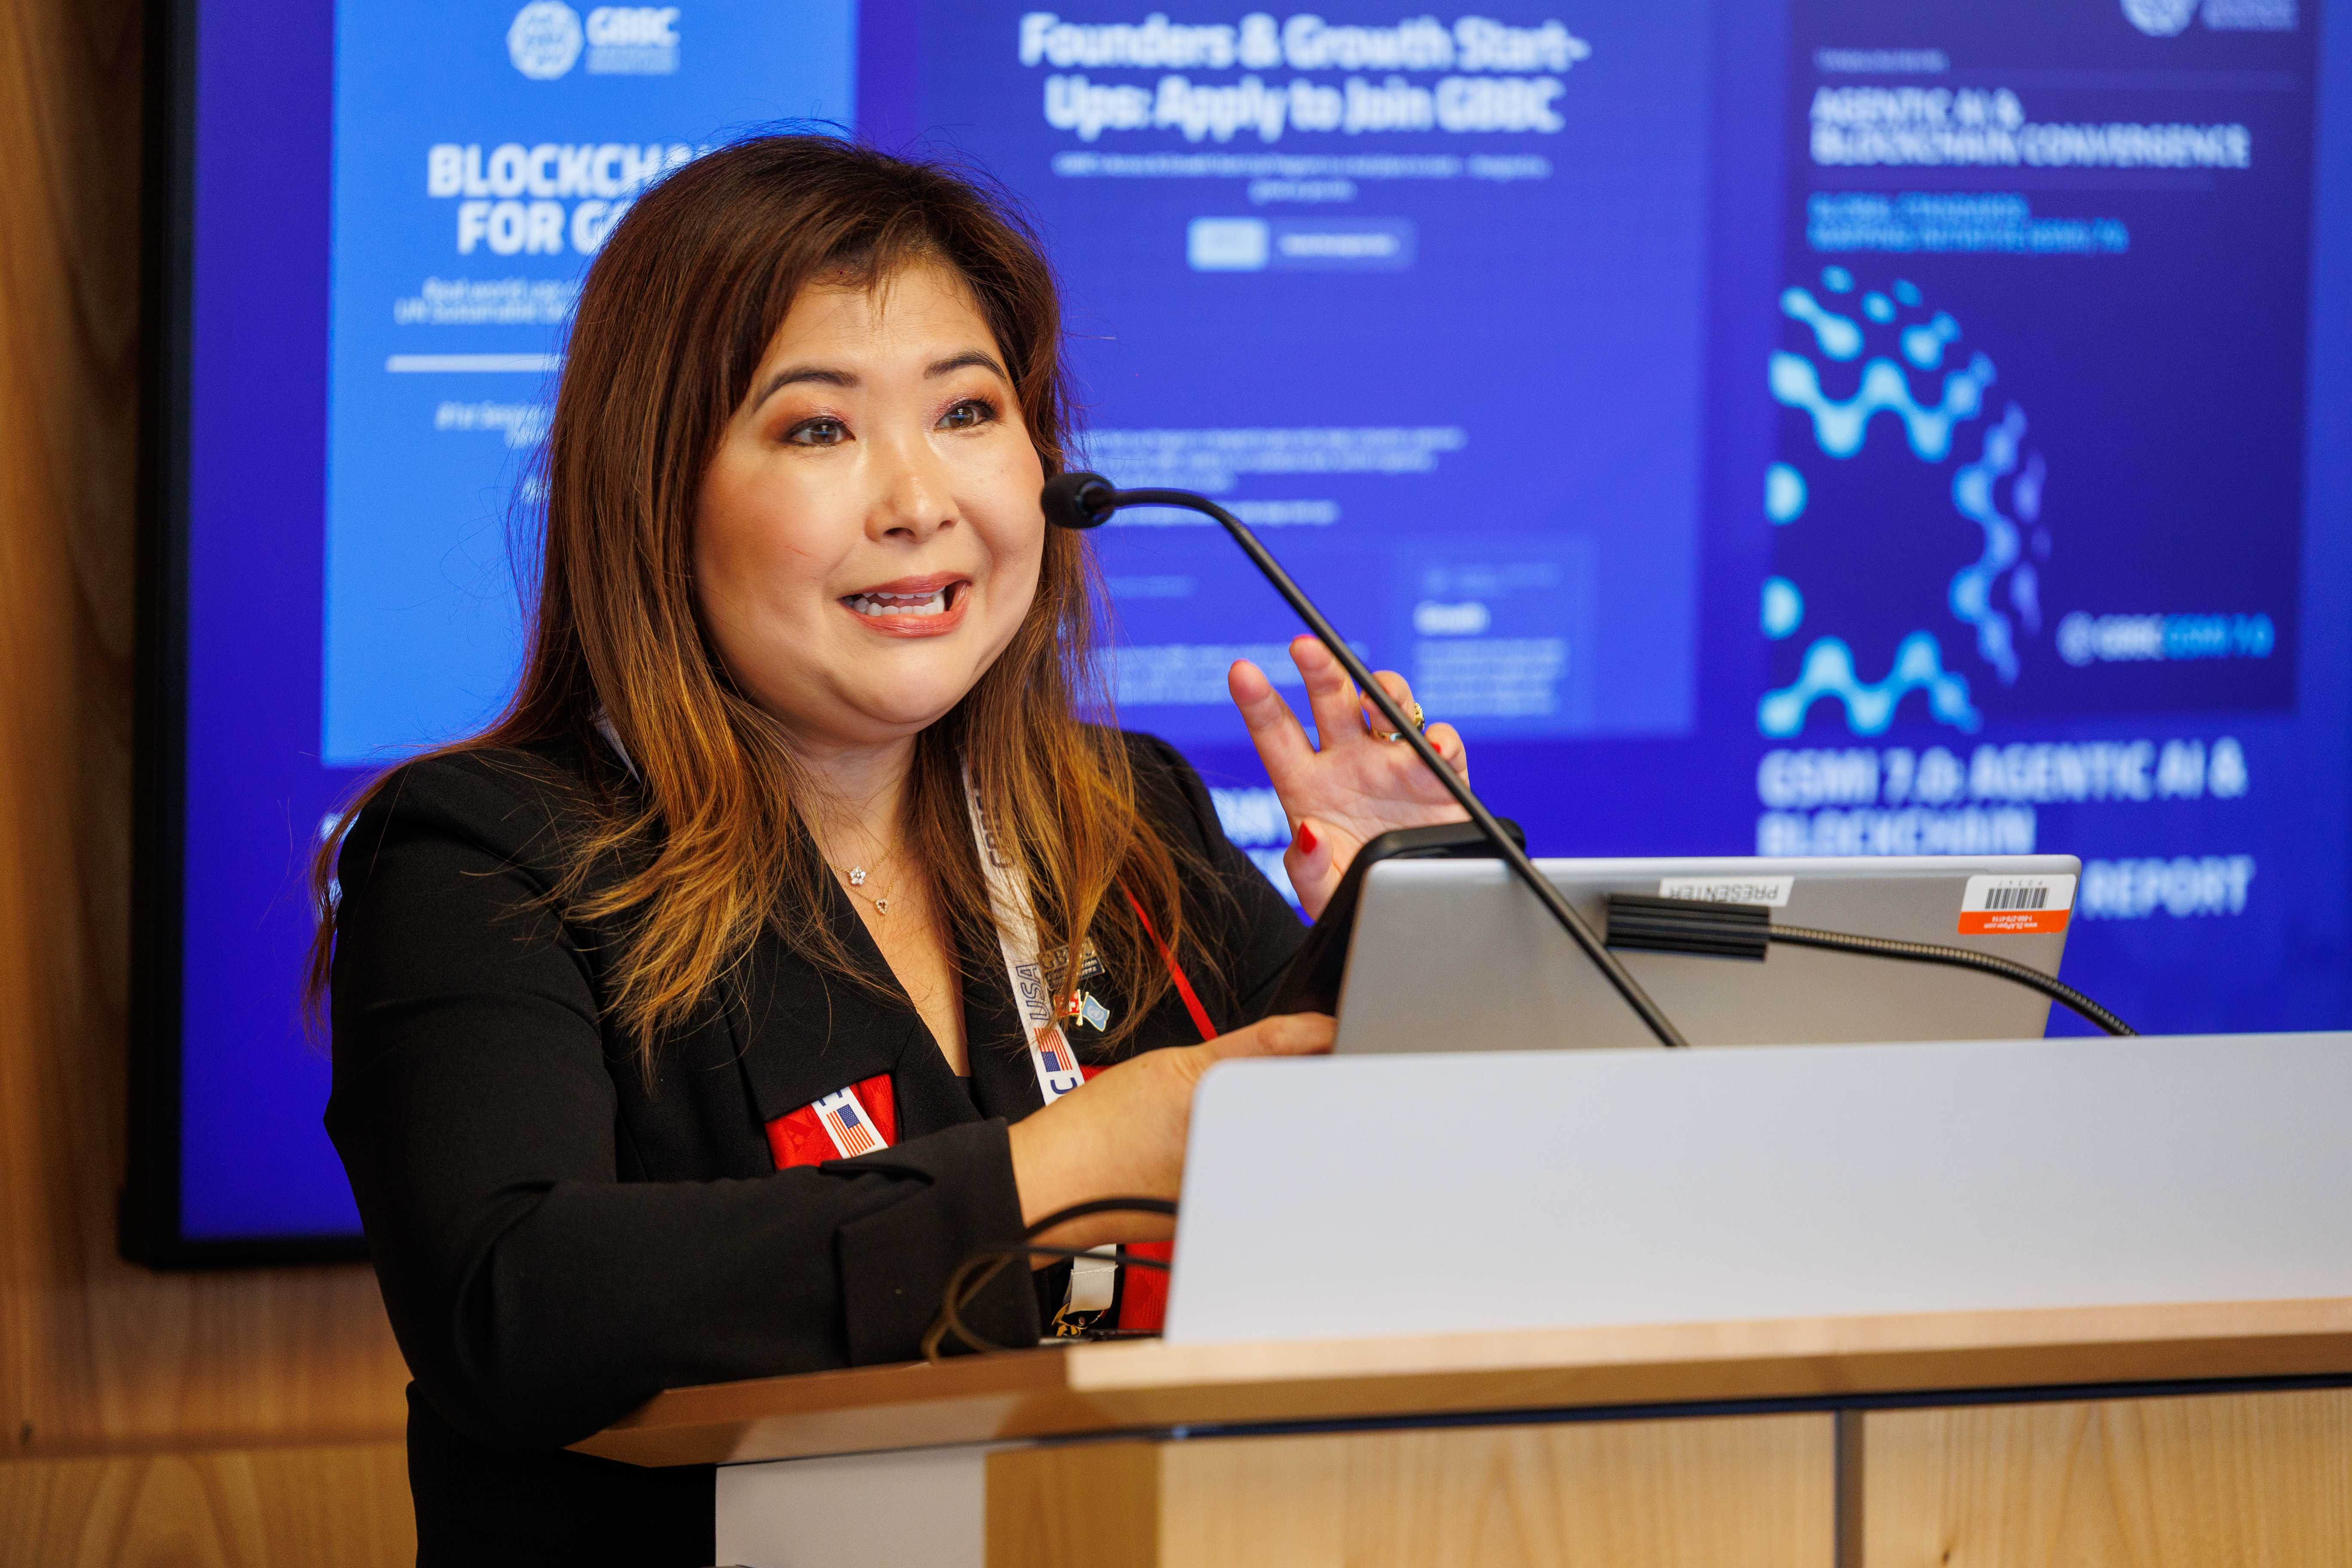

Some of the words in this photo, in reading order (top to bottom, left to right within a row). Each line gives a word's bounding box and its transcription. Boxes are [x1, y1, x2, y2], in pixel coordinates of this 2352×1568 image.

[1020, 13, 1236, 67] Founders
[1239, 14, 1278, 67] &
[1284, 15, 1453, 69] Growth
[1455, 17, 1589, 70] Start-
[1155, 76, 1285, 140] Apply
[1290, 79, 1341, 130] to
[1344, 77, 1433, 132] Join
[1436, 77, 1562, 132] GBBC
[1811, 88, 1952, 126] AGENTIC
[1811, 125, 2020, 164] BLOCKCHAIN
[2022, 124, 2249, 166] CONVERGENCE
[457, 200, 564, 254] FOR
[1758, 750, 1878, 807] GSMI
[1971, 743, 2153, 801] AGENTIC
[2159, 740, 2204, 797] AI
[2208, 738, 2246, 796] &
[1757, 807, 2035, 854] BLOCKCHAIN
[1669, 884, 1779, 902] PRESENTER
[2082, 856, 2255, 916] REPORT
[1016, 962, 1050, 1020] USA
